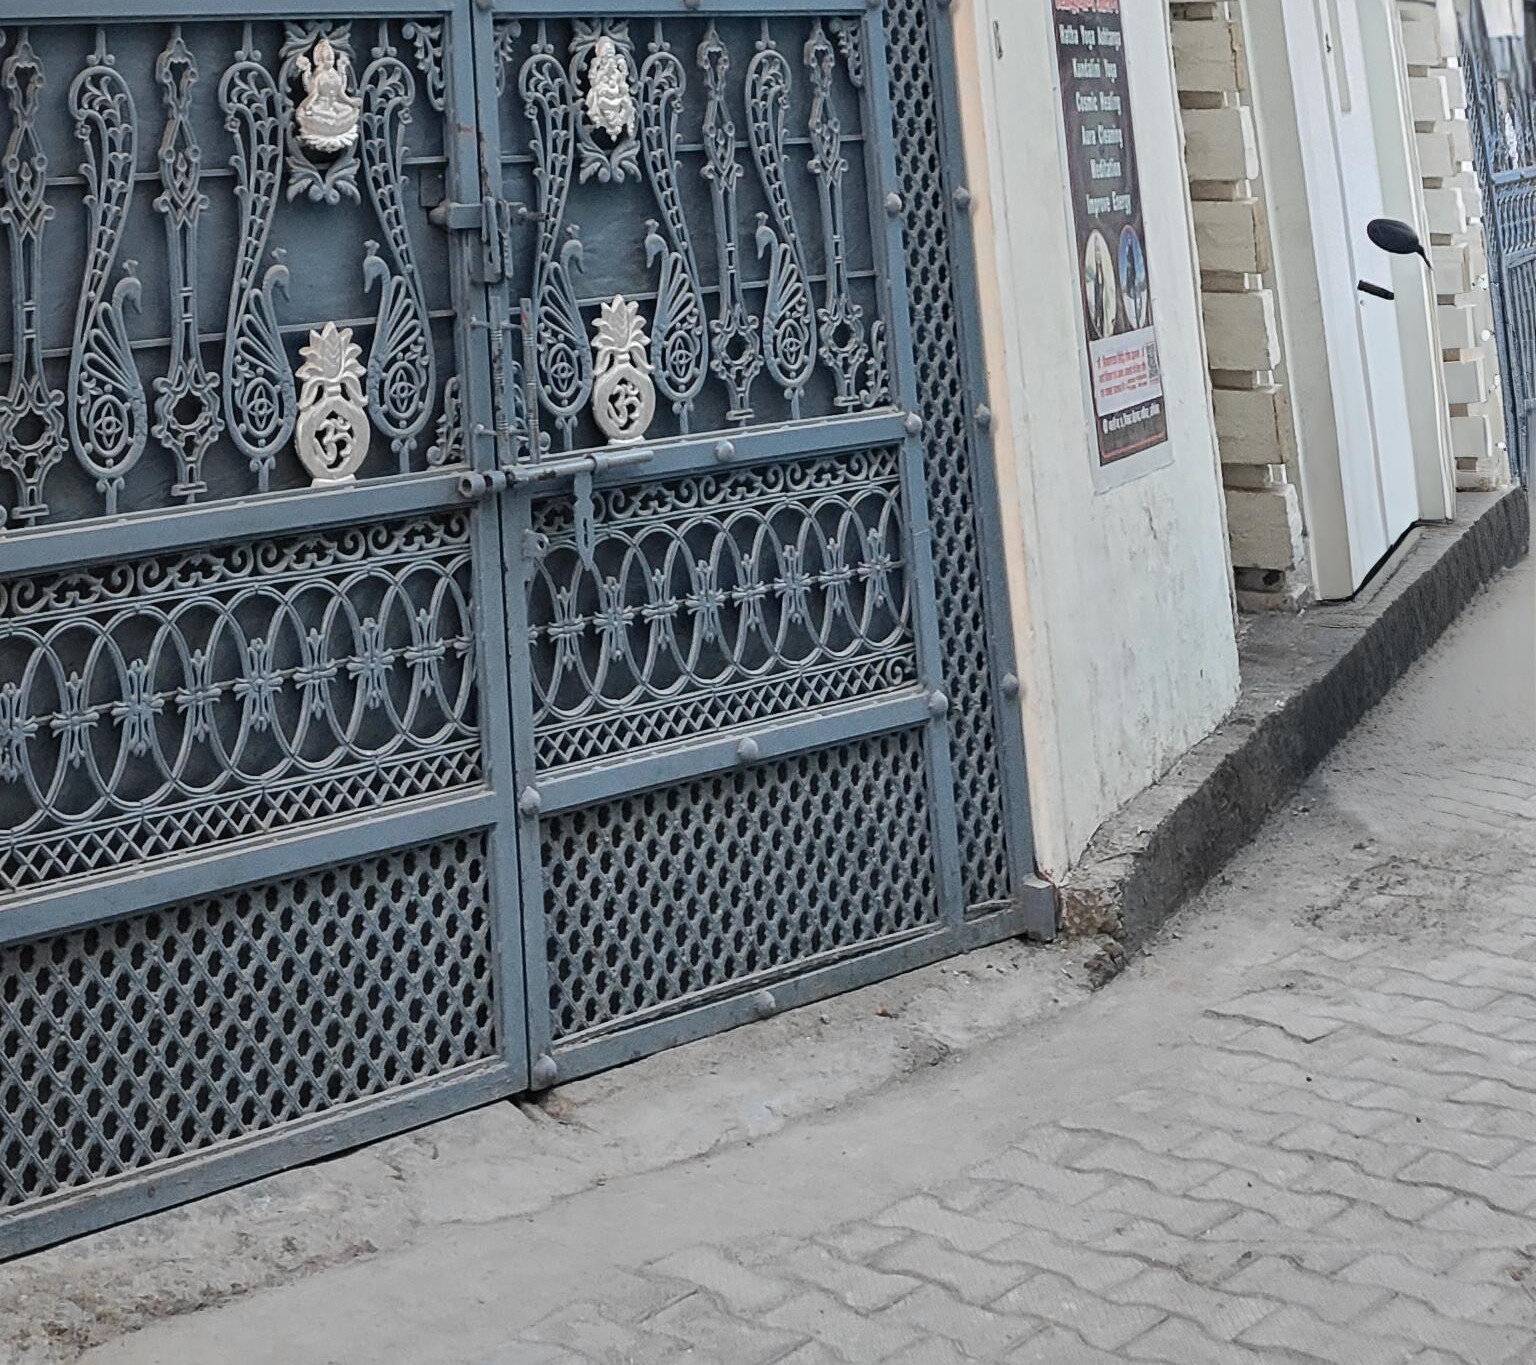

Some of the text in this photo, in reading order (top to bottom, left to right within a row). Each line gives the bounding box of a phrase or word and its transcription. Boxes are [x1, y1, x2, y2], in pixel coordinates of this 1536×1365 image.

[1079, 24, 1095, 50] Yoga
[1103, 58, 1117, 83] Yoga
[1075, 91, 1122, 116] Cosmic Healing
[1081, 124, 1096, 145] Aura
[1090, 158, 1122, 179] Meditation
[1086, 190, 1132, 219] Improve Energy
